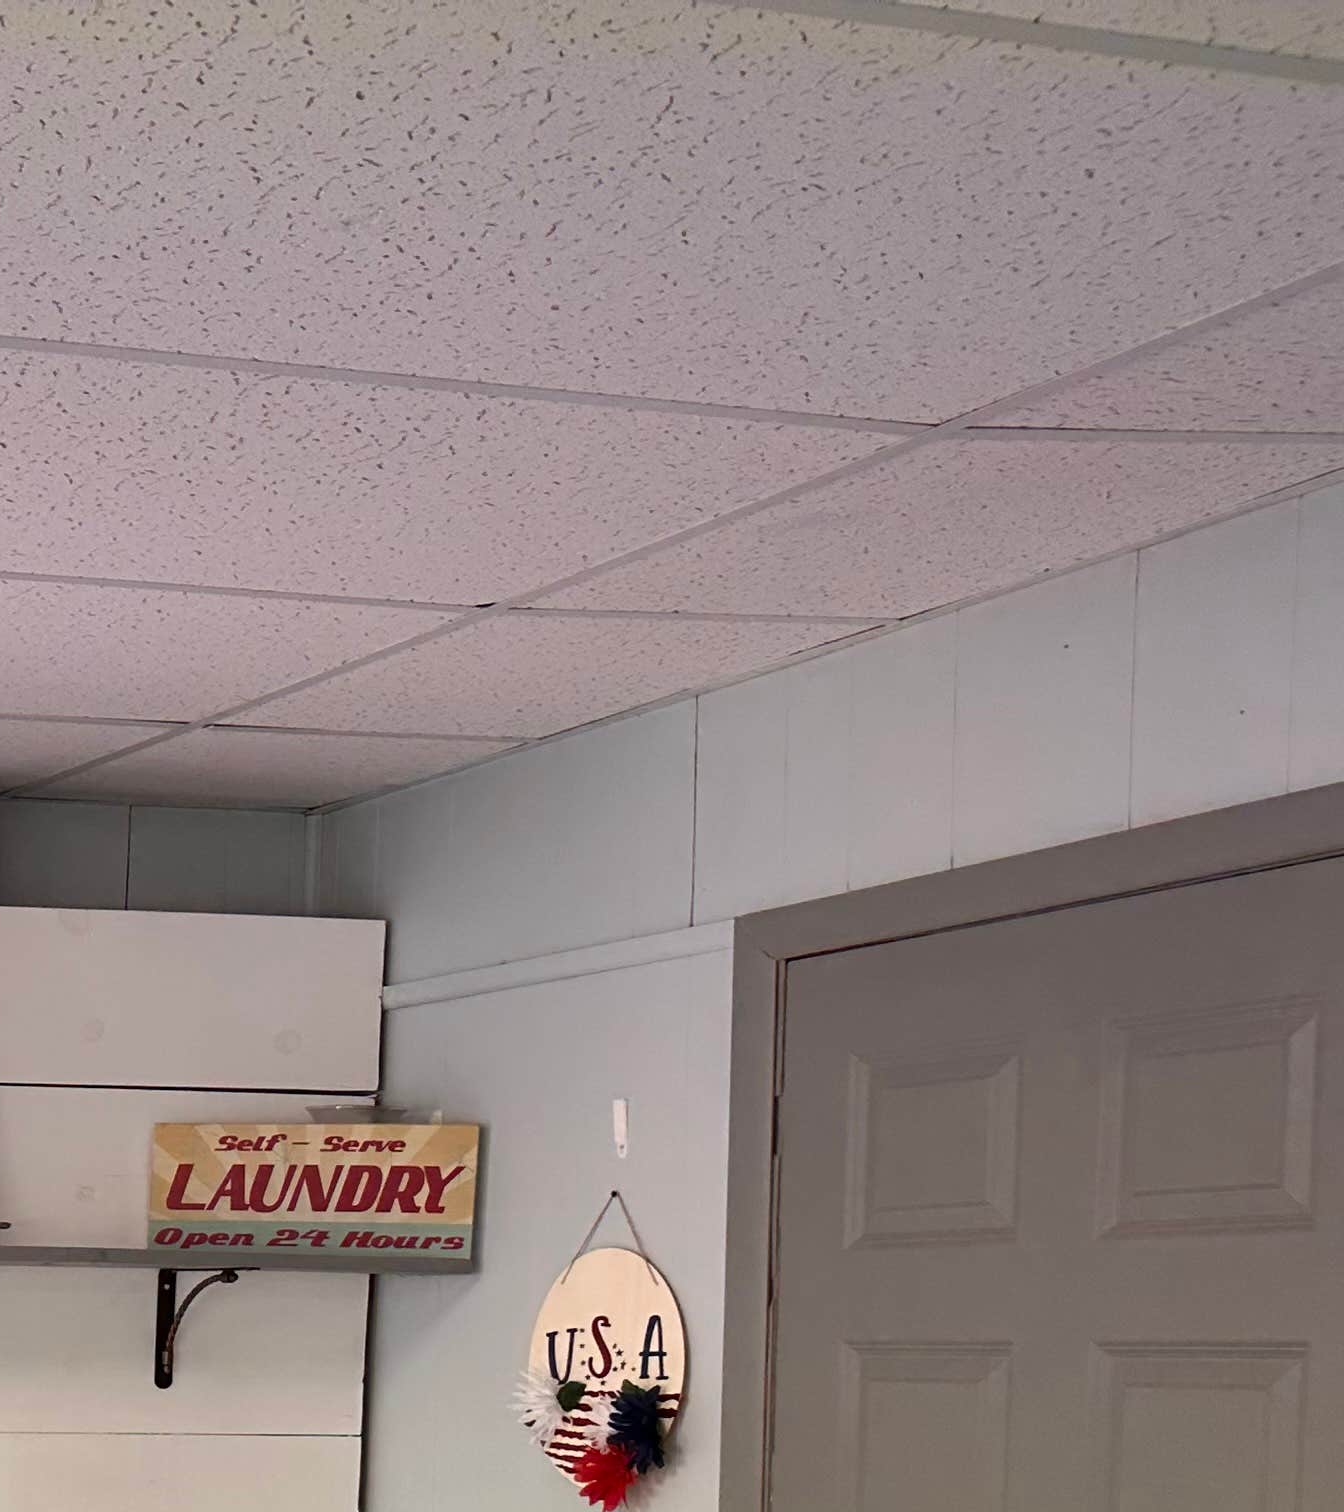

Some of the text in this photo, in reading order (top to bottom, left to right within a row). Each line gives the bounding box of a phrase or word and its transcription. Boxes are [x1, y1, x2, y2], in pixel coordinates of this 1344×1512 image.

[215, 1133, 287, 1152] Self
[320, 1135, 406, 1153] Serve
[166, 1163, 466, 1214] LAUNDRY
[154, 1227, 465, 1251] Open 24 Hours
